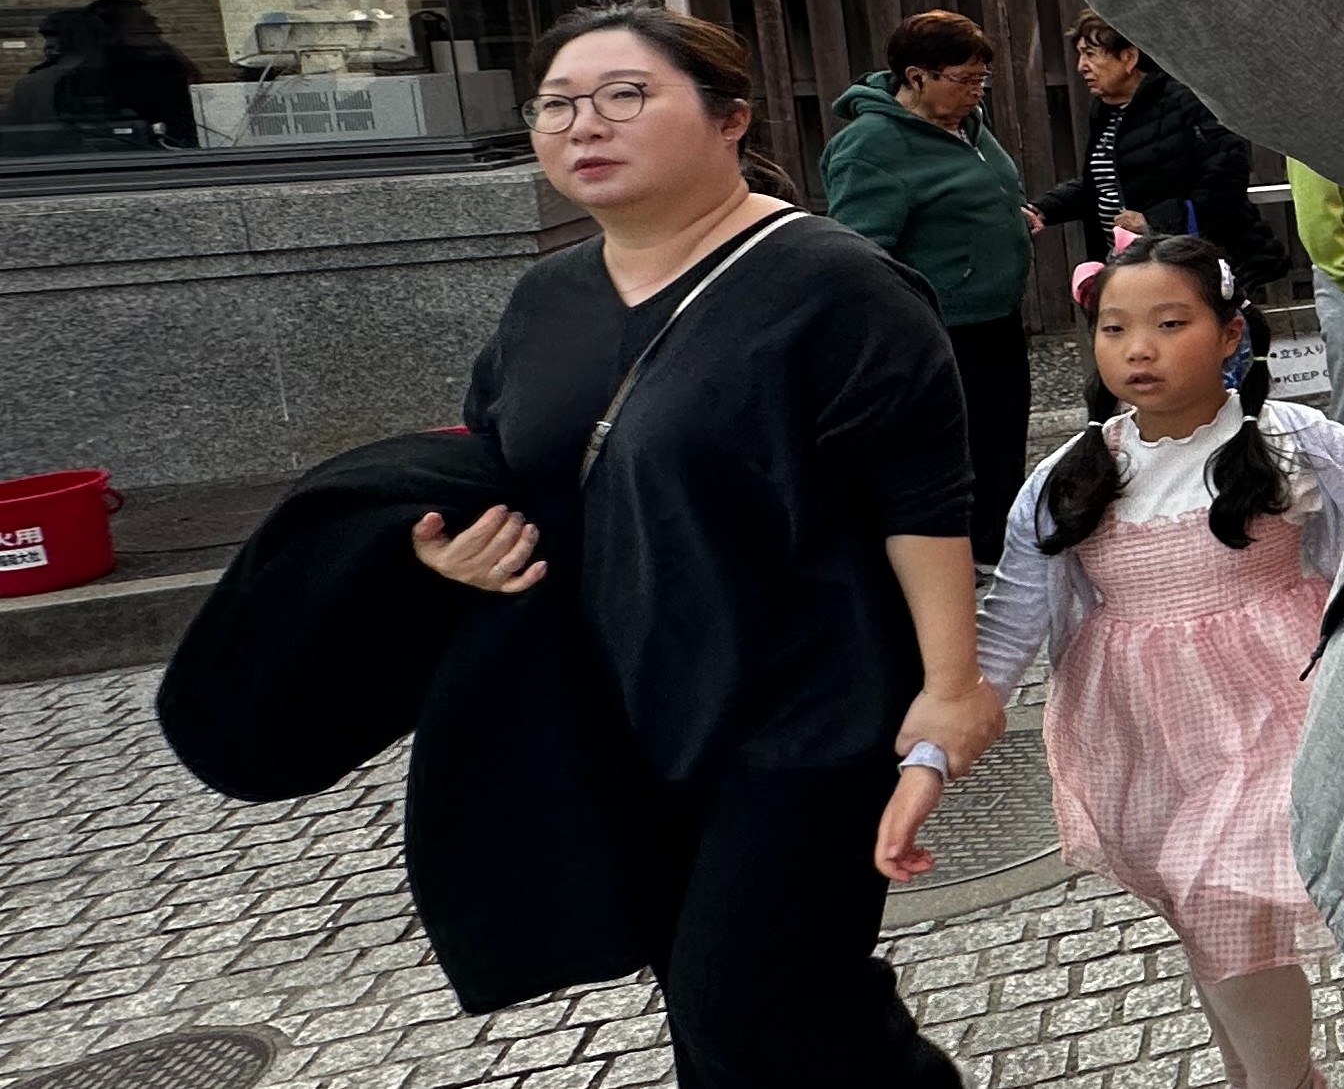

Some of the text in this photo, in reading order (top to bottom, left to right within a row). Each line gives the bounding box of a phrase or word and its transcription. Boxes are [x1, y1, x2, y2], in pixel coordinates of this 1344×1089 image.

[1279, 343, 1325, 359] 立ち入り
[1283, 370, 1320, 383] KEEP
